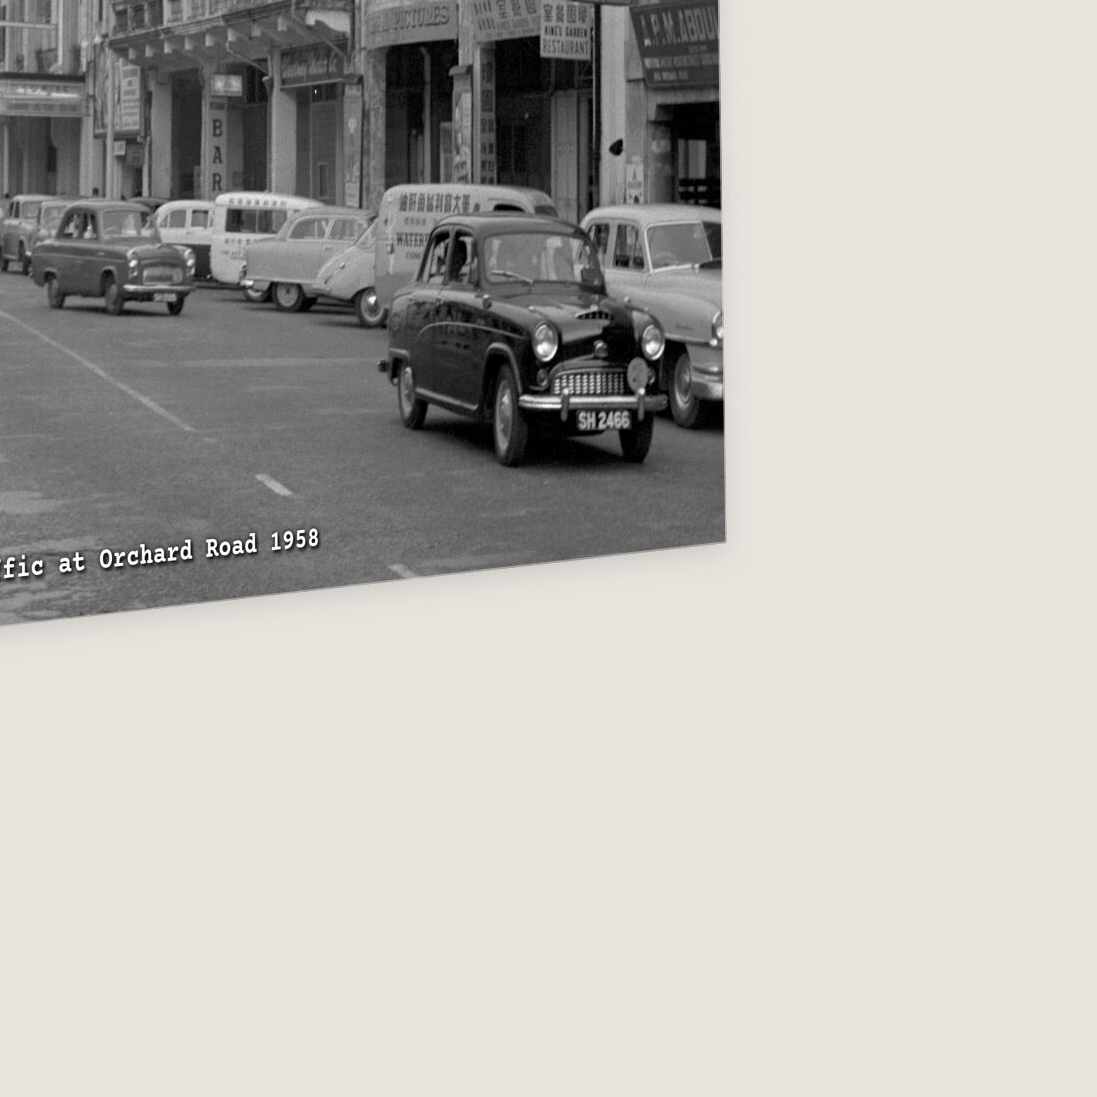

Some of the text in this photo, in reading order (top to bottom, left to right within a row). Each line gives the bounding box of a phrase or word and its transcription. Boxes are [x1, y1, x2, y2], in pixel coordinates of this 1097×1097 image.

[542, 38, 590, 56] RESTAURANT
[212, 118, 223, 192] BAR
[577, 410, 630, 431] SH 2466
